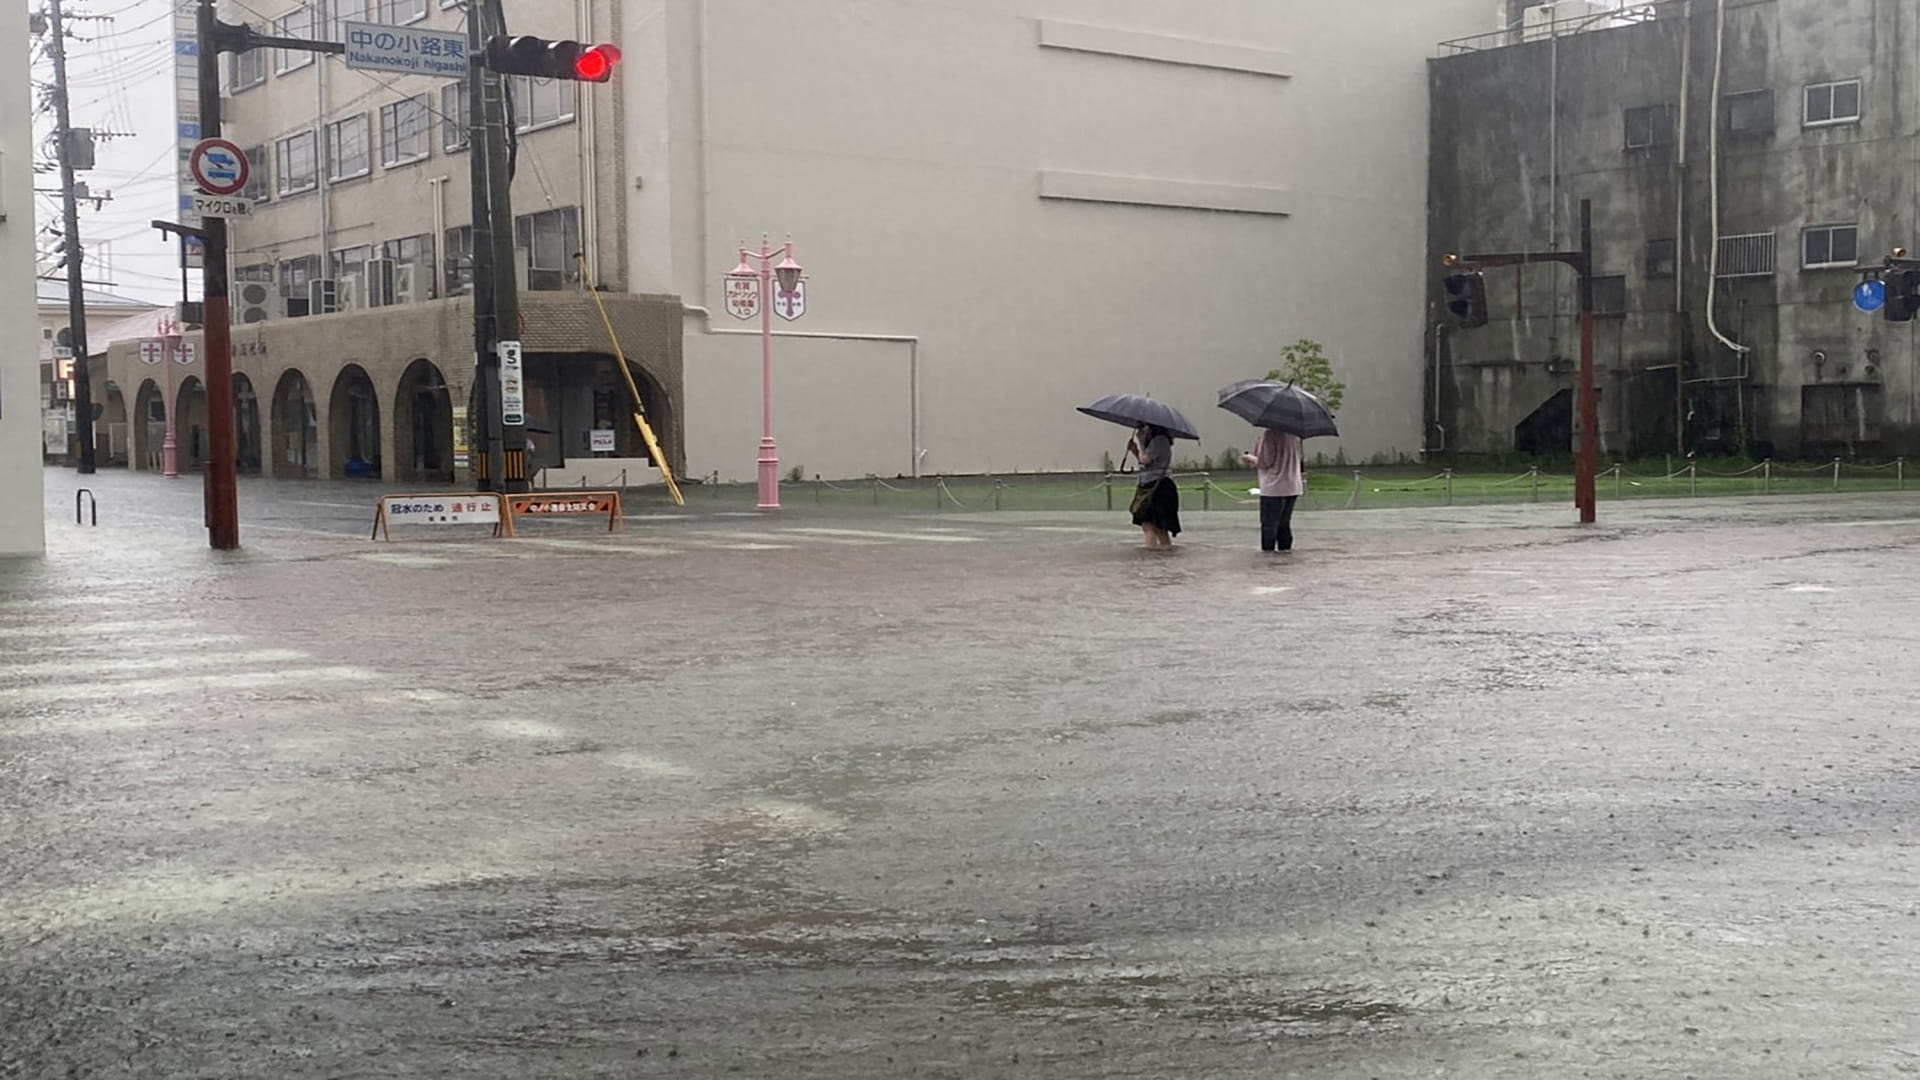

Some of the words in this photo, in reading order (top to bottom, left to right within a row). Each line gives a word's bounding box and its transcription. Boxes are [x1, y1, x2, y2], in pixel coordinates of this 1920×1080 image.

[350, 30, 465, 58] 中の小路東
[350, 51, 419, 69] Nakanokoji
[423, 60, 466, 72] higashi
[391, 503, 445, 514] 冠水のため
